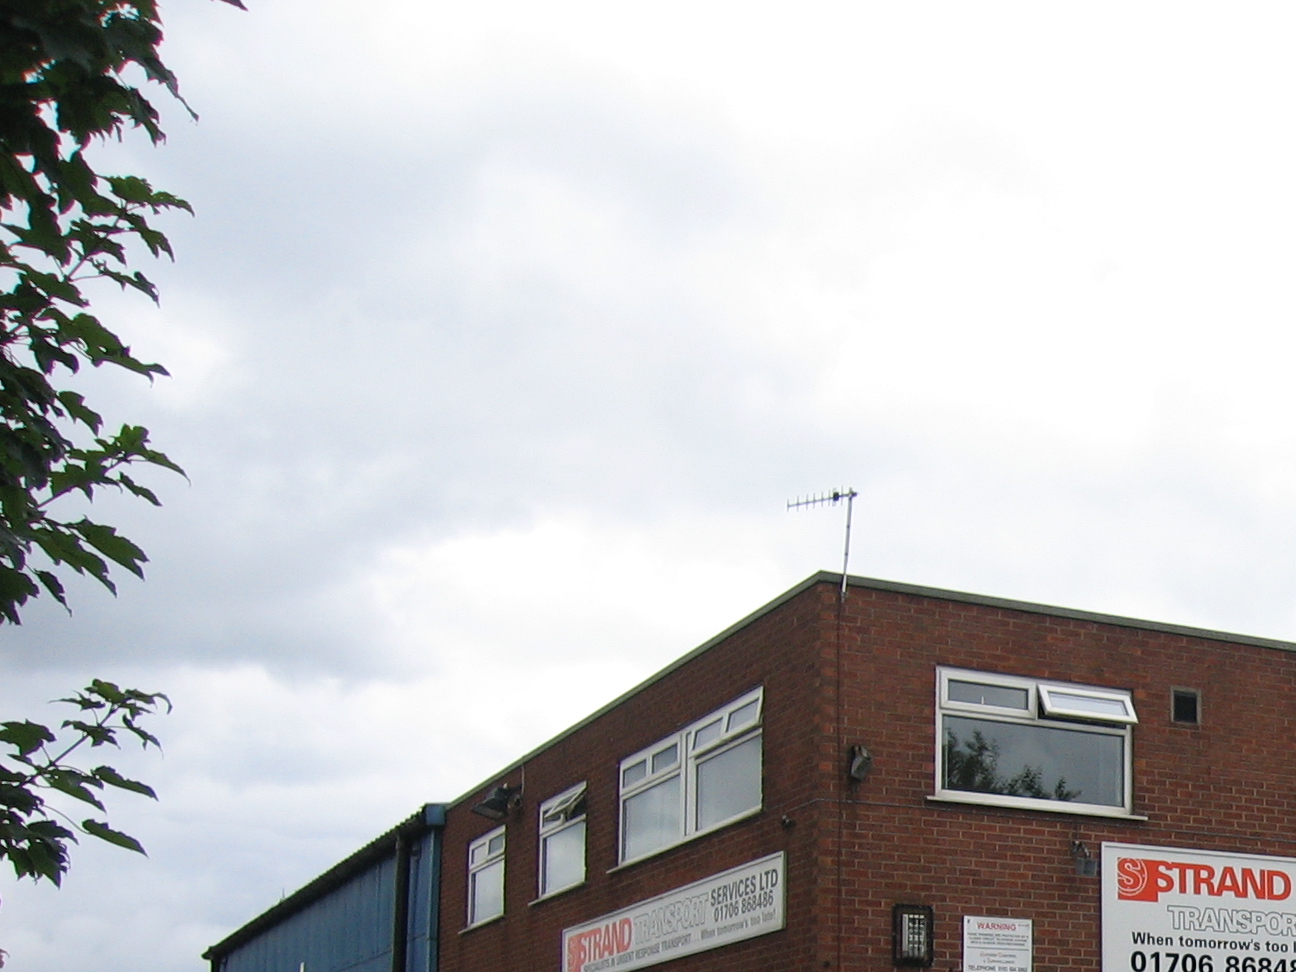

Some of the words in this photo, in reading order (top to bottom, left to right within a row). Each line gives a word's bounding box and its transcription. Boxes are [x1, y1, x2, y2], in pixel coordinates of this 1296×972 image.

[710, 875, 757, 907] SERVICES
[759, 869, 779, 891] LTD
[1156, 860, 1292, 901] STRAND
[634, 893, 710, 945] TRANSPORT
[713, 900, 740, 922] 01706
[977, 922, 1016, 931] WARNING
[580, 917, 633, 963] STRAND
[1131, 931, 1174, 947] When
[1179, 935, 1261, 952] tomorrow's
[1265, 940, 1289, 953] too
